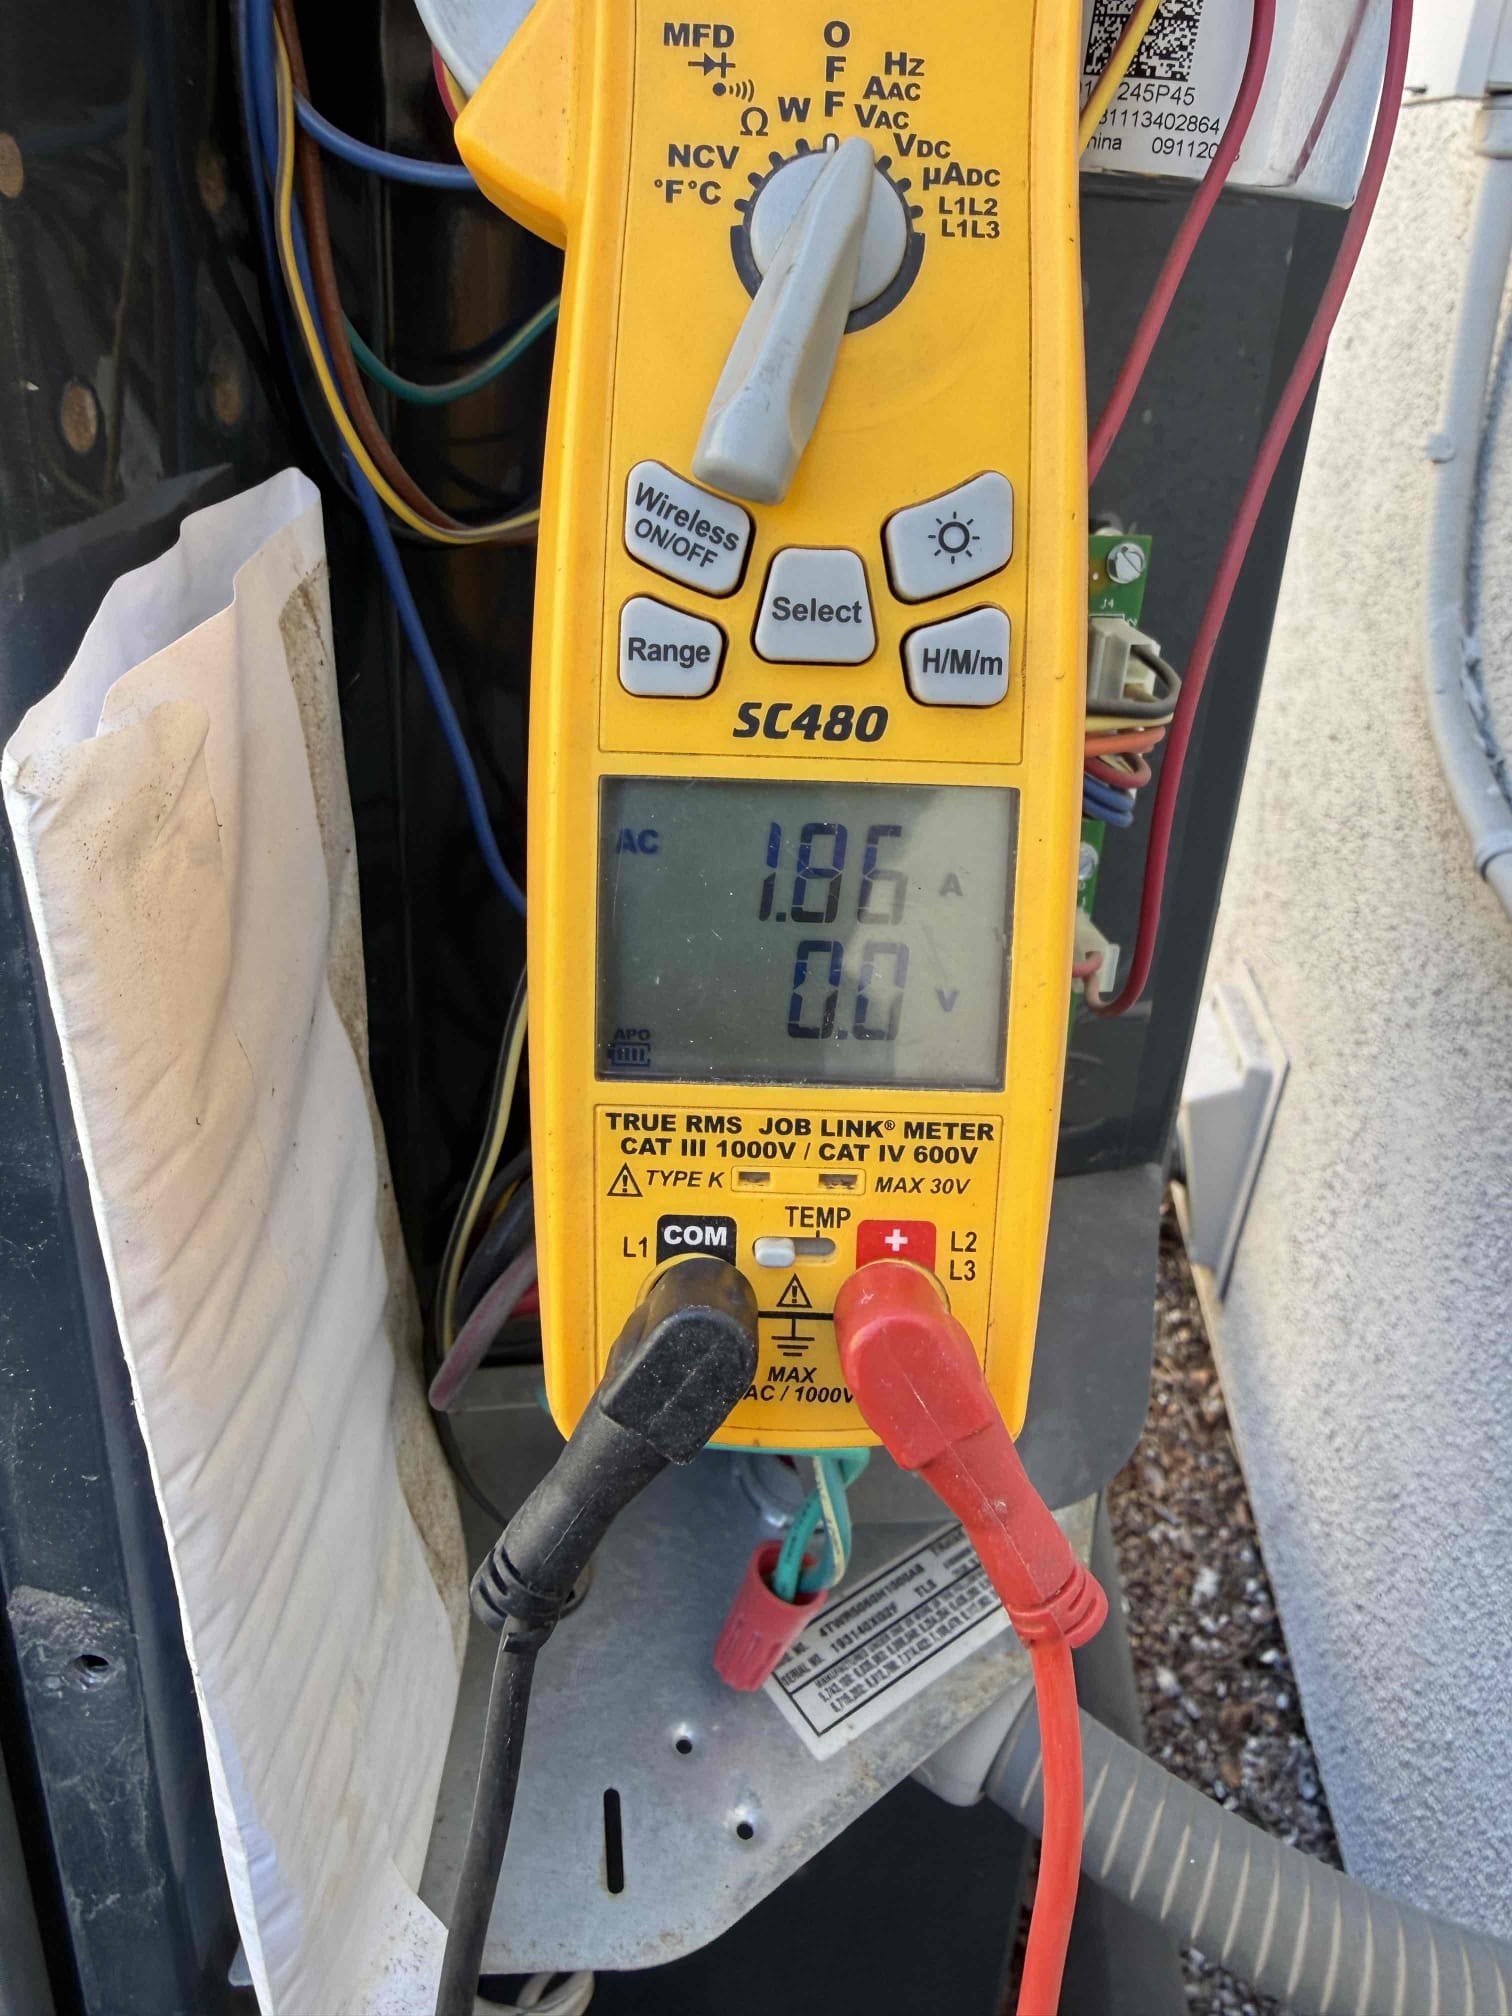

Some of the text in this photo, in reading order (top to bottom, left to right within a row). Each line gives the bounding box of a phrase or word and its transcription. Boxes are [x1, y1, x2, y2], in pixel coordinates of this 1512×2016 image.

[663, 22, 735, 48] MFD
[884, 51, 925, 76] Hz
[778, 97, 811, 123] W
[667, 144, 740, 169] NCV
[938, 196, 998, 216] L1L2
[942, 219, 1000, 239] L1L3
[634, 482, 740, 551] Wireless
[635, 518, 718, 569] ON/OFF
[772, 596, 862, 623] Select
[628, 637, 711, 669] Range
[923, 647, 1003, 676] H/M/m
[732, 702, 889, 743] SC480
[618, 829, 659, 855] AC
[759, 822, 963, 925] 1.86 A
[787, 939, 909, 1041] 0.0
[614, 1028, 651, 1042] APO
[606, 1112, 677, 1133] TRUE
[685, 1115, 742, 1134] RMS
[759, 1118, 811, 1136] JOB
[904, 1121, 994, 1141] METER
[620, 1137, 672, 1156] CAT
[681, 1139, 706, 1157] III
[716, 1140, 796, 1160] 1000V
[818, 1143, 870, 1163] CAT
[878, 1144, 905, 1163] IV
[913, 1145, 979, 1165] 600V
[646, 1169, 724, 1188] TYPE K
[875, 1176, 971, 1195] MAX 30V
[785, 1206, 851, 1230] TEMP
[623, 1225, 977, 1258] L1 COM L2
[949, 1259, 976, 1281] L3
[768, 1366, 817, 1383] MAX
